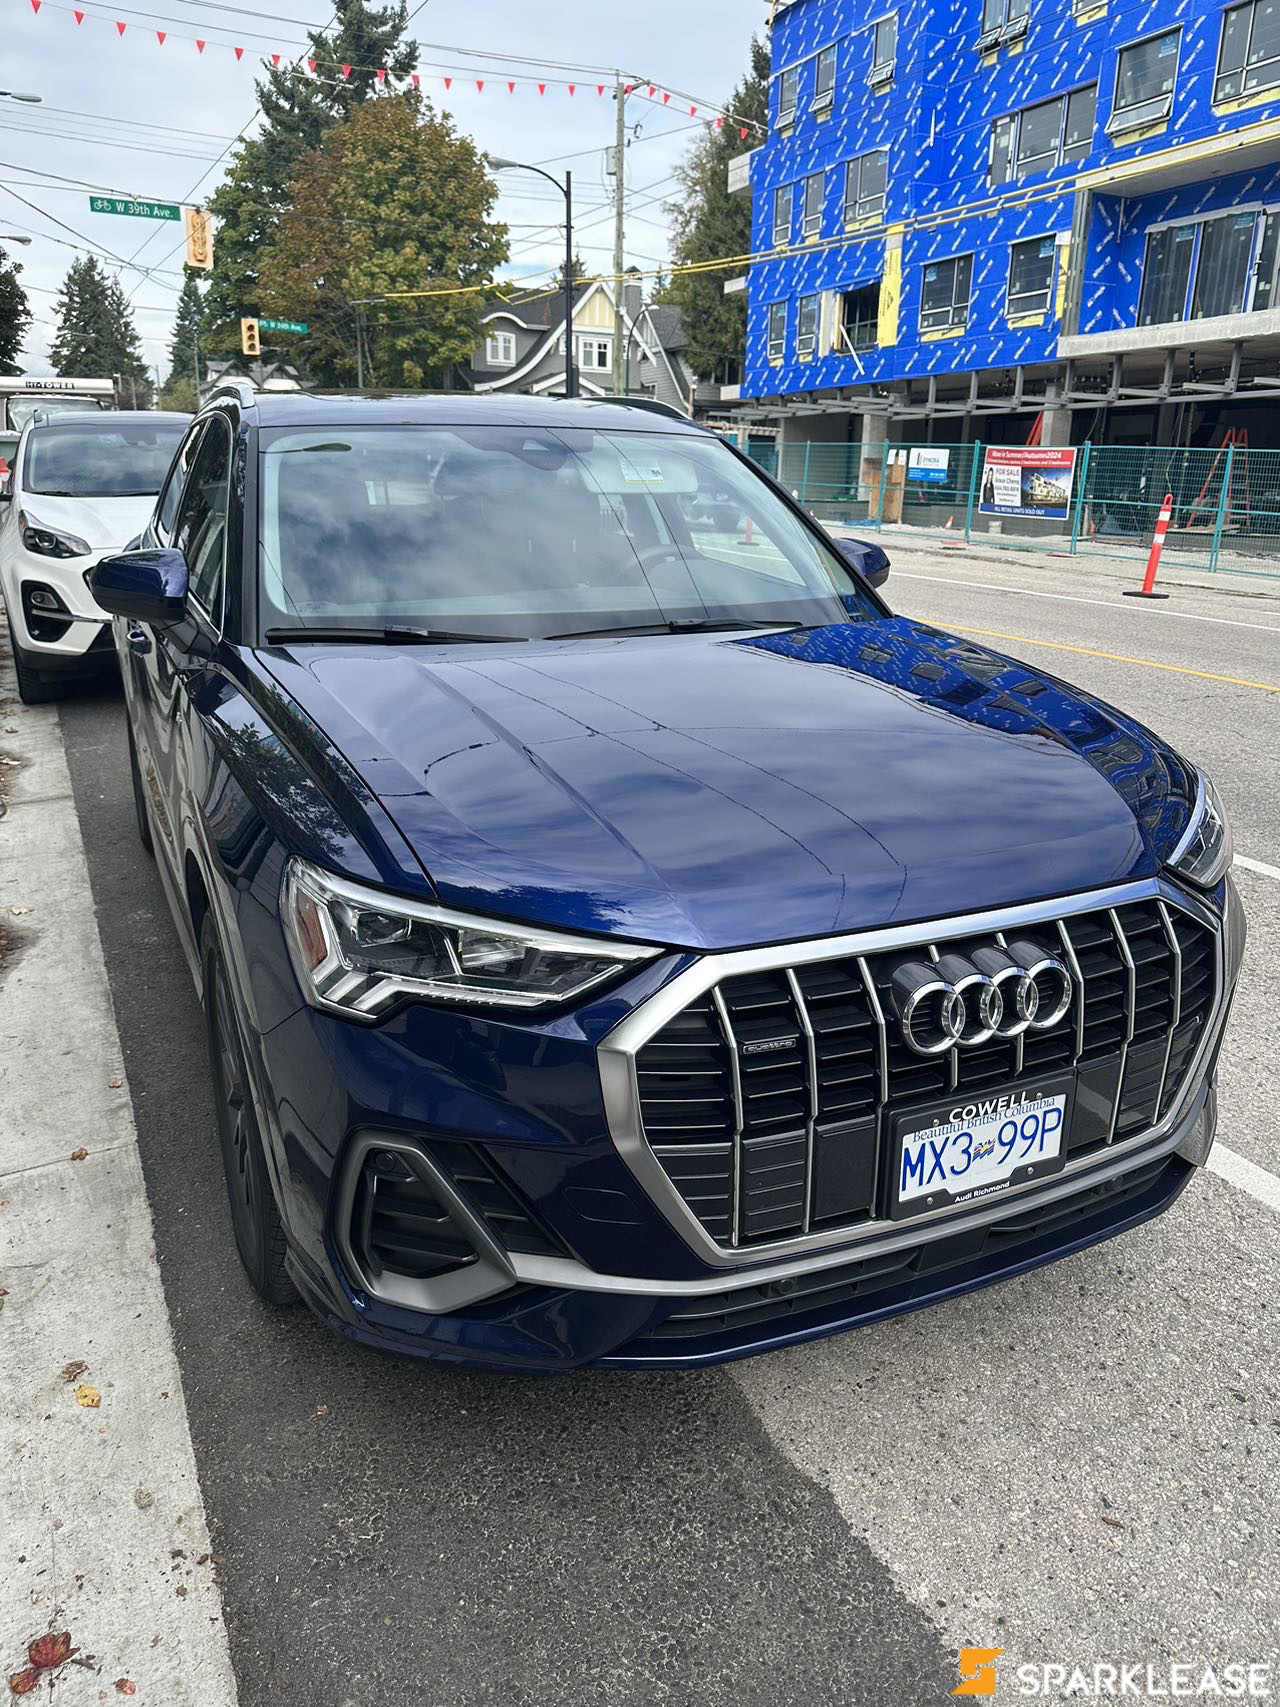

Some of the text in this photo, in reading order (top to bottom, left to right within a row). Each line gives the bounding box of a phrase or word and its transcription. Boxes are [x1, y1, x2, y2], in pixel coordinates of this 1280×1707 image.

[116, 202, 125, 212] W
[128, 203, 150, 215] 39th
[912, 1098, 1055, 1142] Beautiful British Columbia
[949, 1091, 1030, 1123] COWELL
[901, 1107, 1062, 1192] MX3 99P
[954, 1181, 1010, 1203] Audi Richmond
